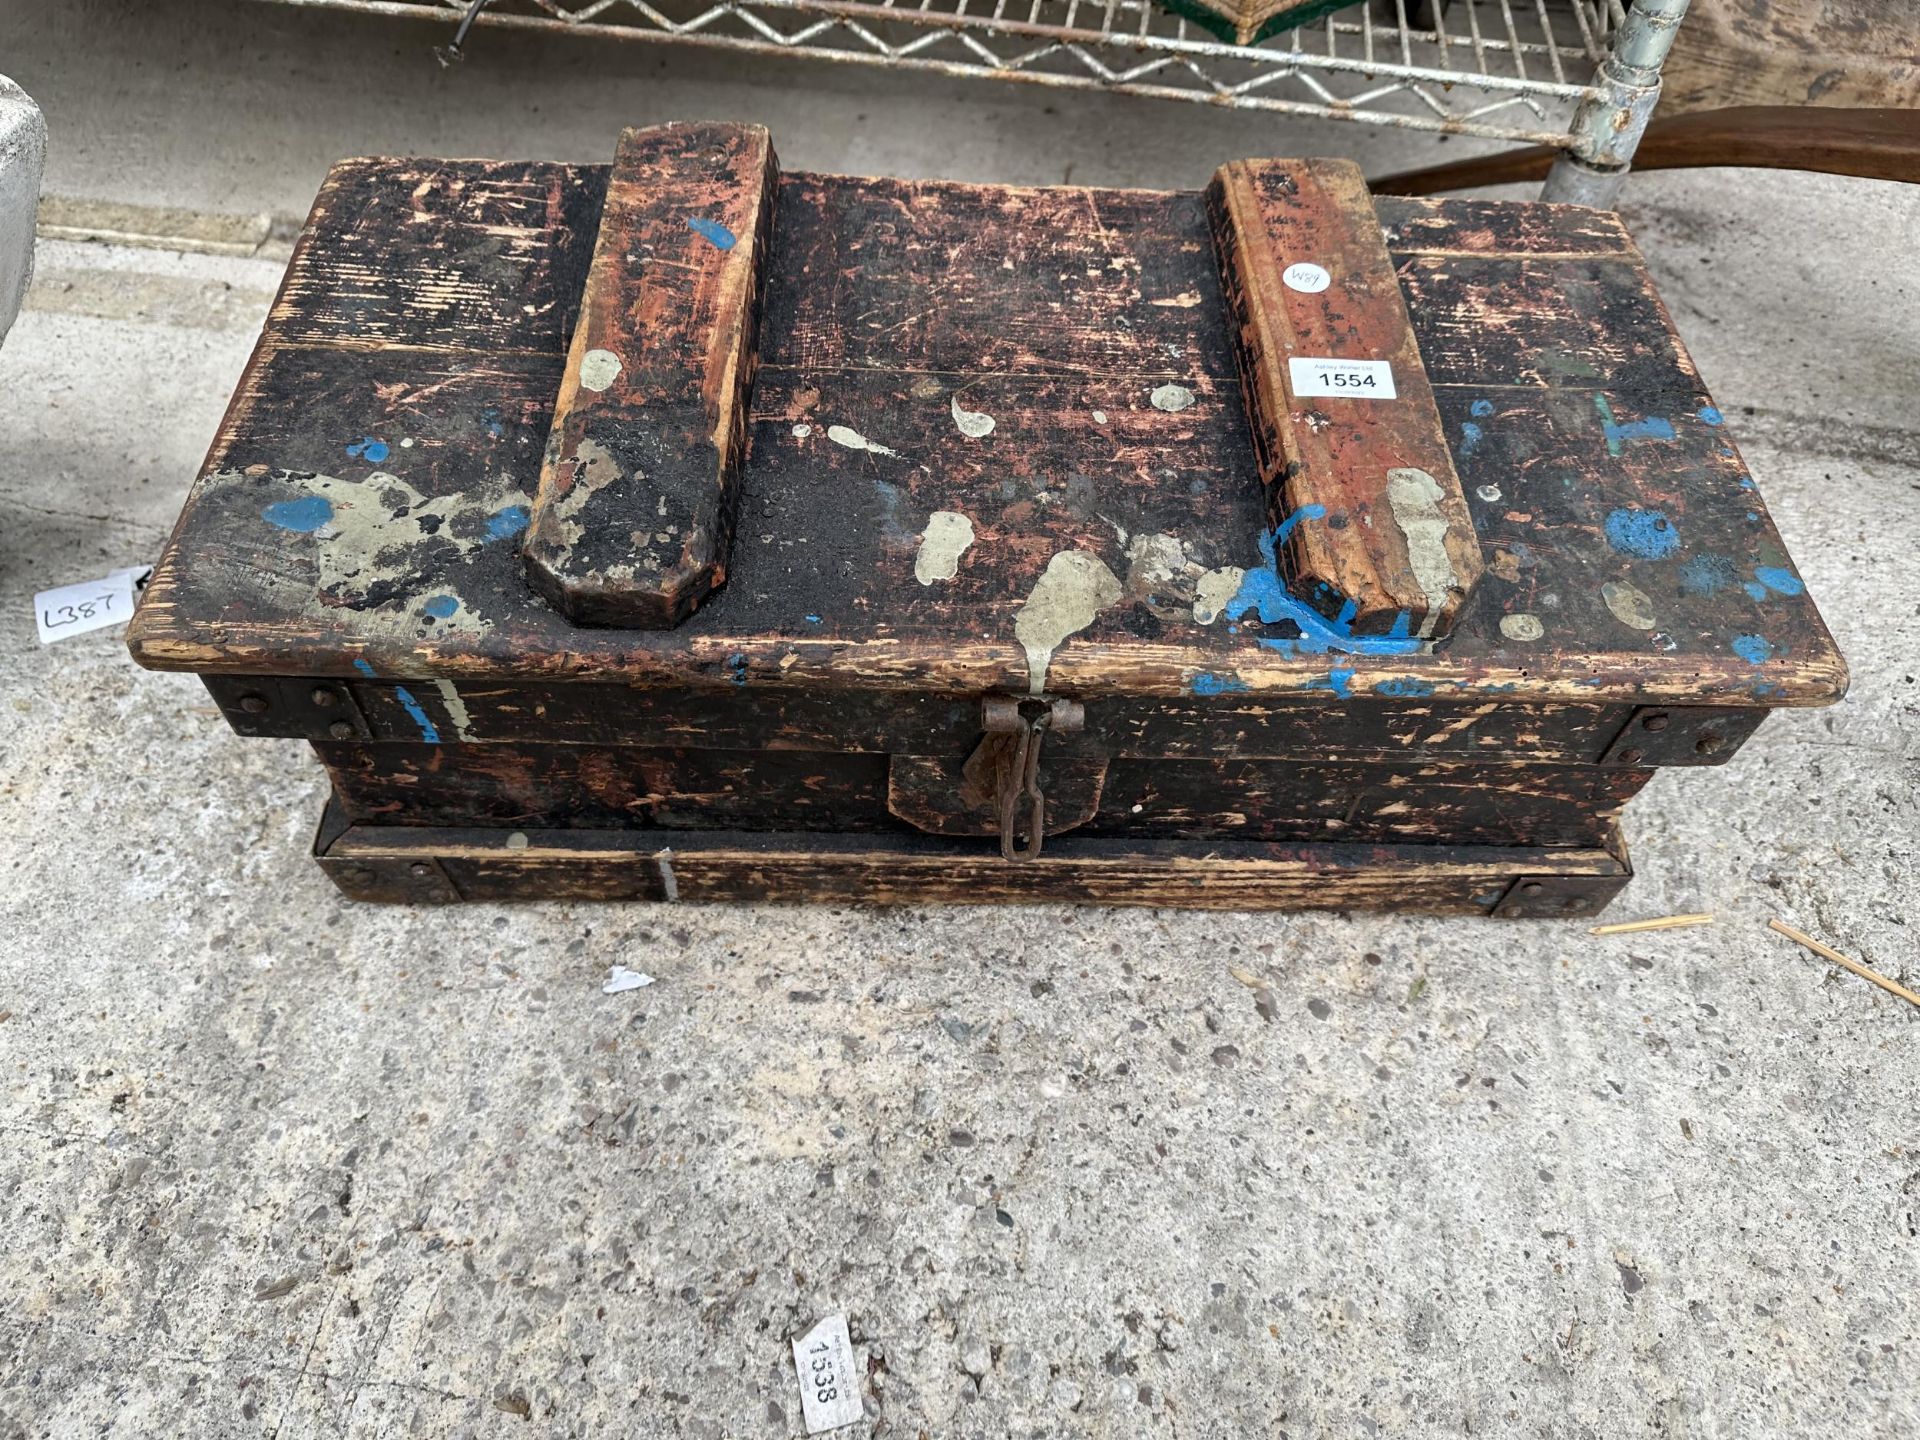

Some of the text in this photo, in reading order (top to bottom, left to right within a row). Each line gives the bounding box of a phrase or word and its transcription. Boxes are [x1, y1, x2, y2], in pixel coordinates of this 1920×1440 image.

[1319, 373, 1377, 388] 1554
[44, 593, 114, 629] L387
[809, 1341, 838, 1404] 1538
